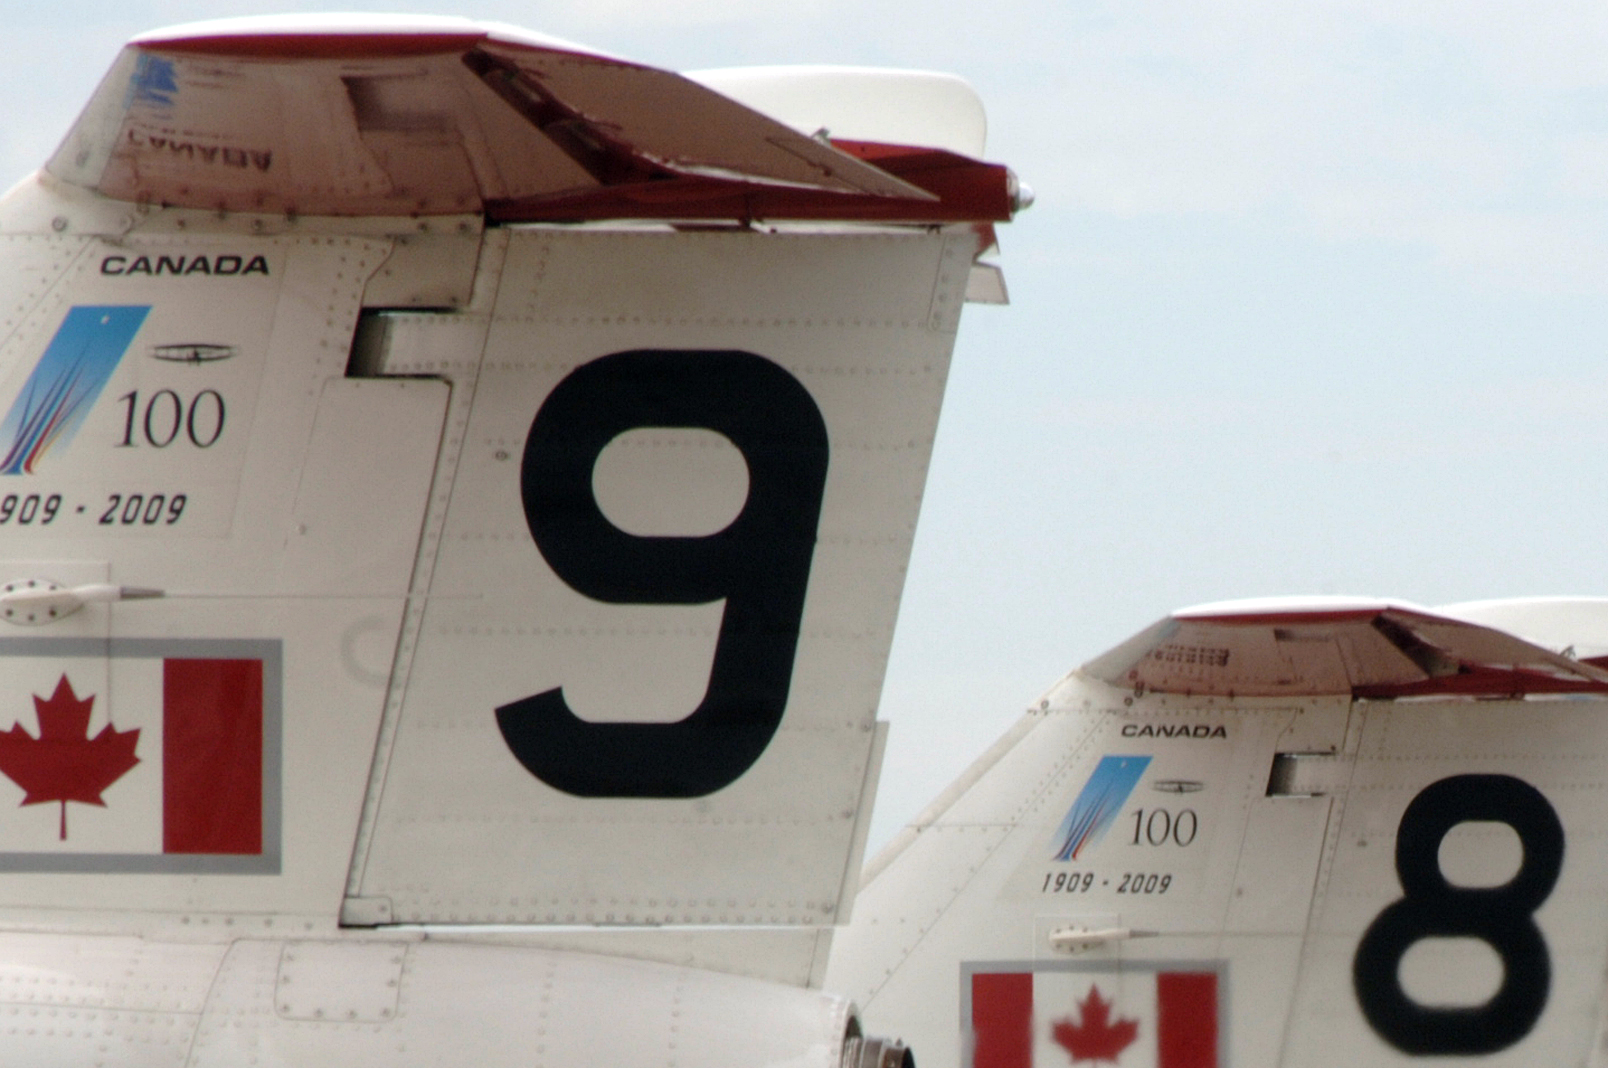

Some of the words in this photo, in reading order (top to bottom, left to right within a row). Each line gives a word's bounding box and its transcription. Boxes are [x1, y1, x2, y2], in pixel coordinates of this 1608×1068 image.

[100, 254, 270, 276] CANADA
[113, 389, 226, 449] 100
[98, 493, 188, 526] 2009
[494, 347, 830, 800] 9
[1121, 724, 1228, 739] CANADA
[1129, 808, 1199, 847] 100
[1042, 872, 1095, 894] 1909
[1116, 872, 1173, 895] 2009
[1351, 772, 1566, 1058] 8
